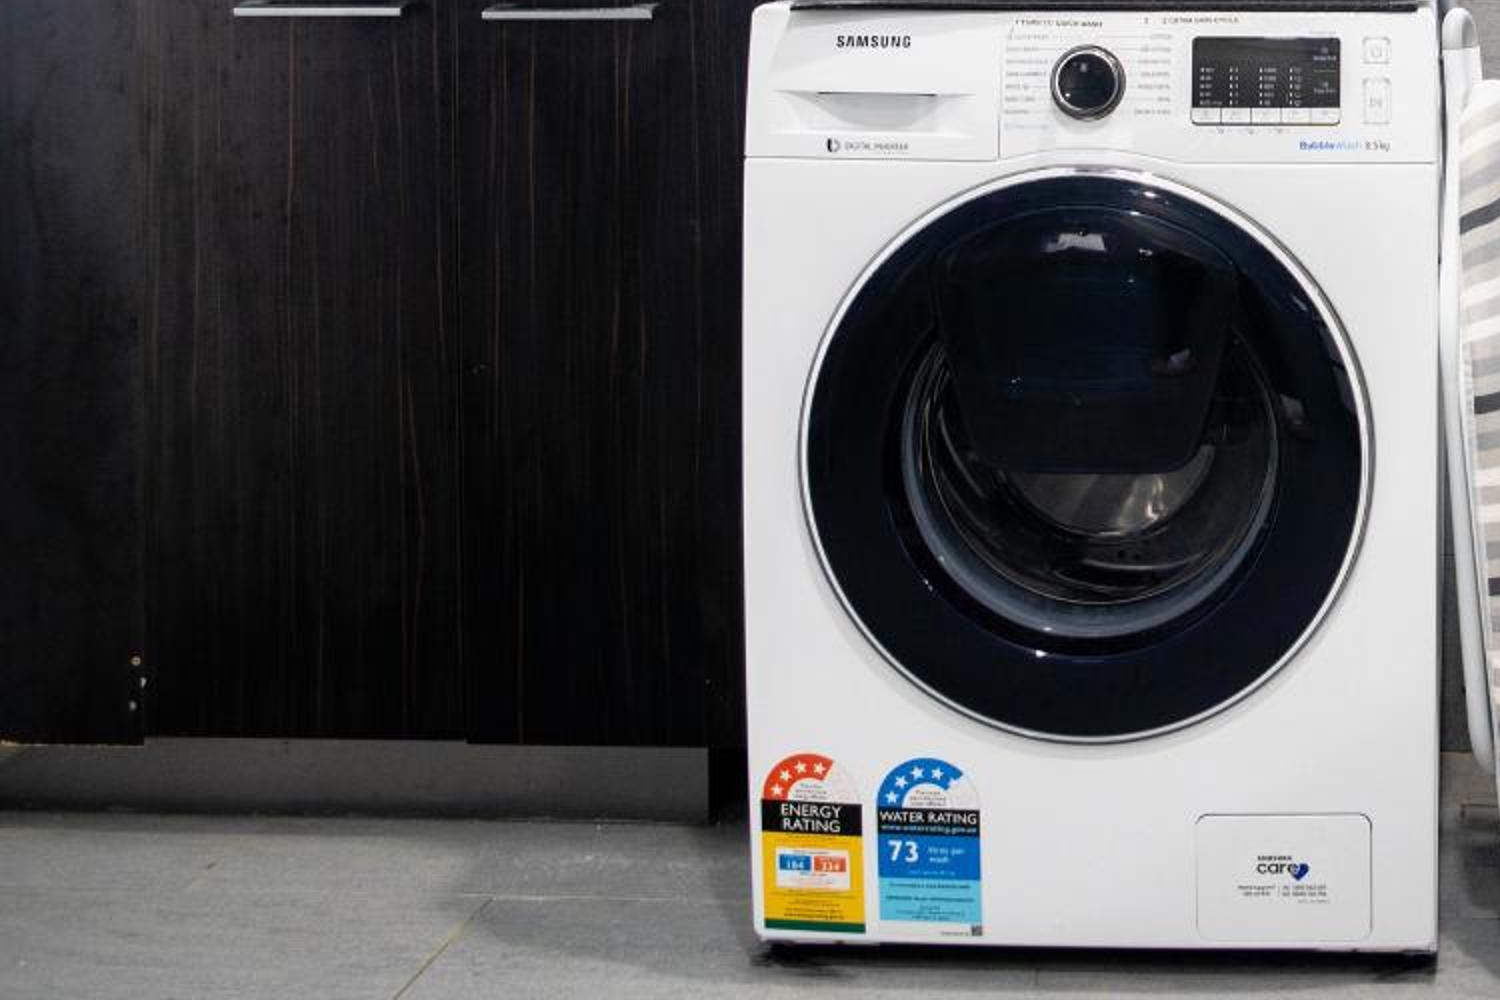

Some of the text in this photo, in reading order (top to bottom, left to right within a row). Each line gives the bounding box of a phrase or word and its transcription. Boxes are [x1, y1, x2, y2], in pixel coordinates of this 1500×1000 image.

[836, 35, 912, 49] SAMSUNG
[780, 804, 842, 818] ENERGY
[879, 810, 978, 825] WATER RATING
[783, 818, 841, 833] RATING
[887, 840, 920, 863] 73
[1256, 862, 1299, 875] care
